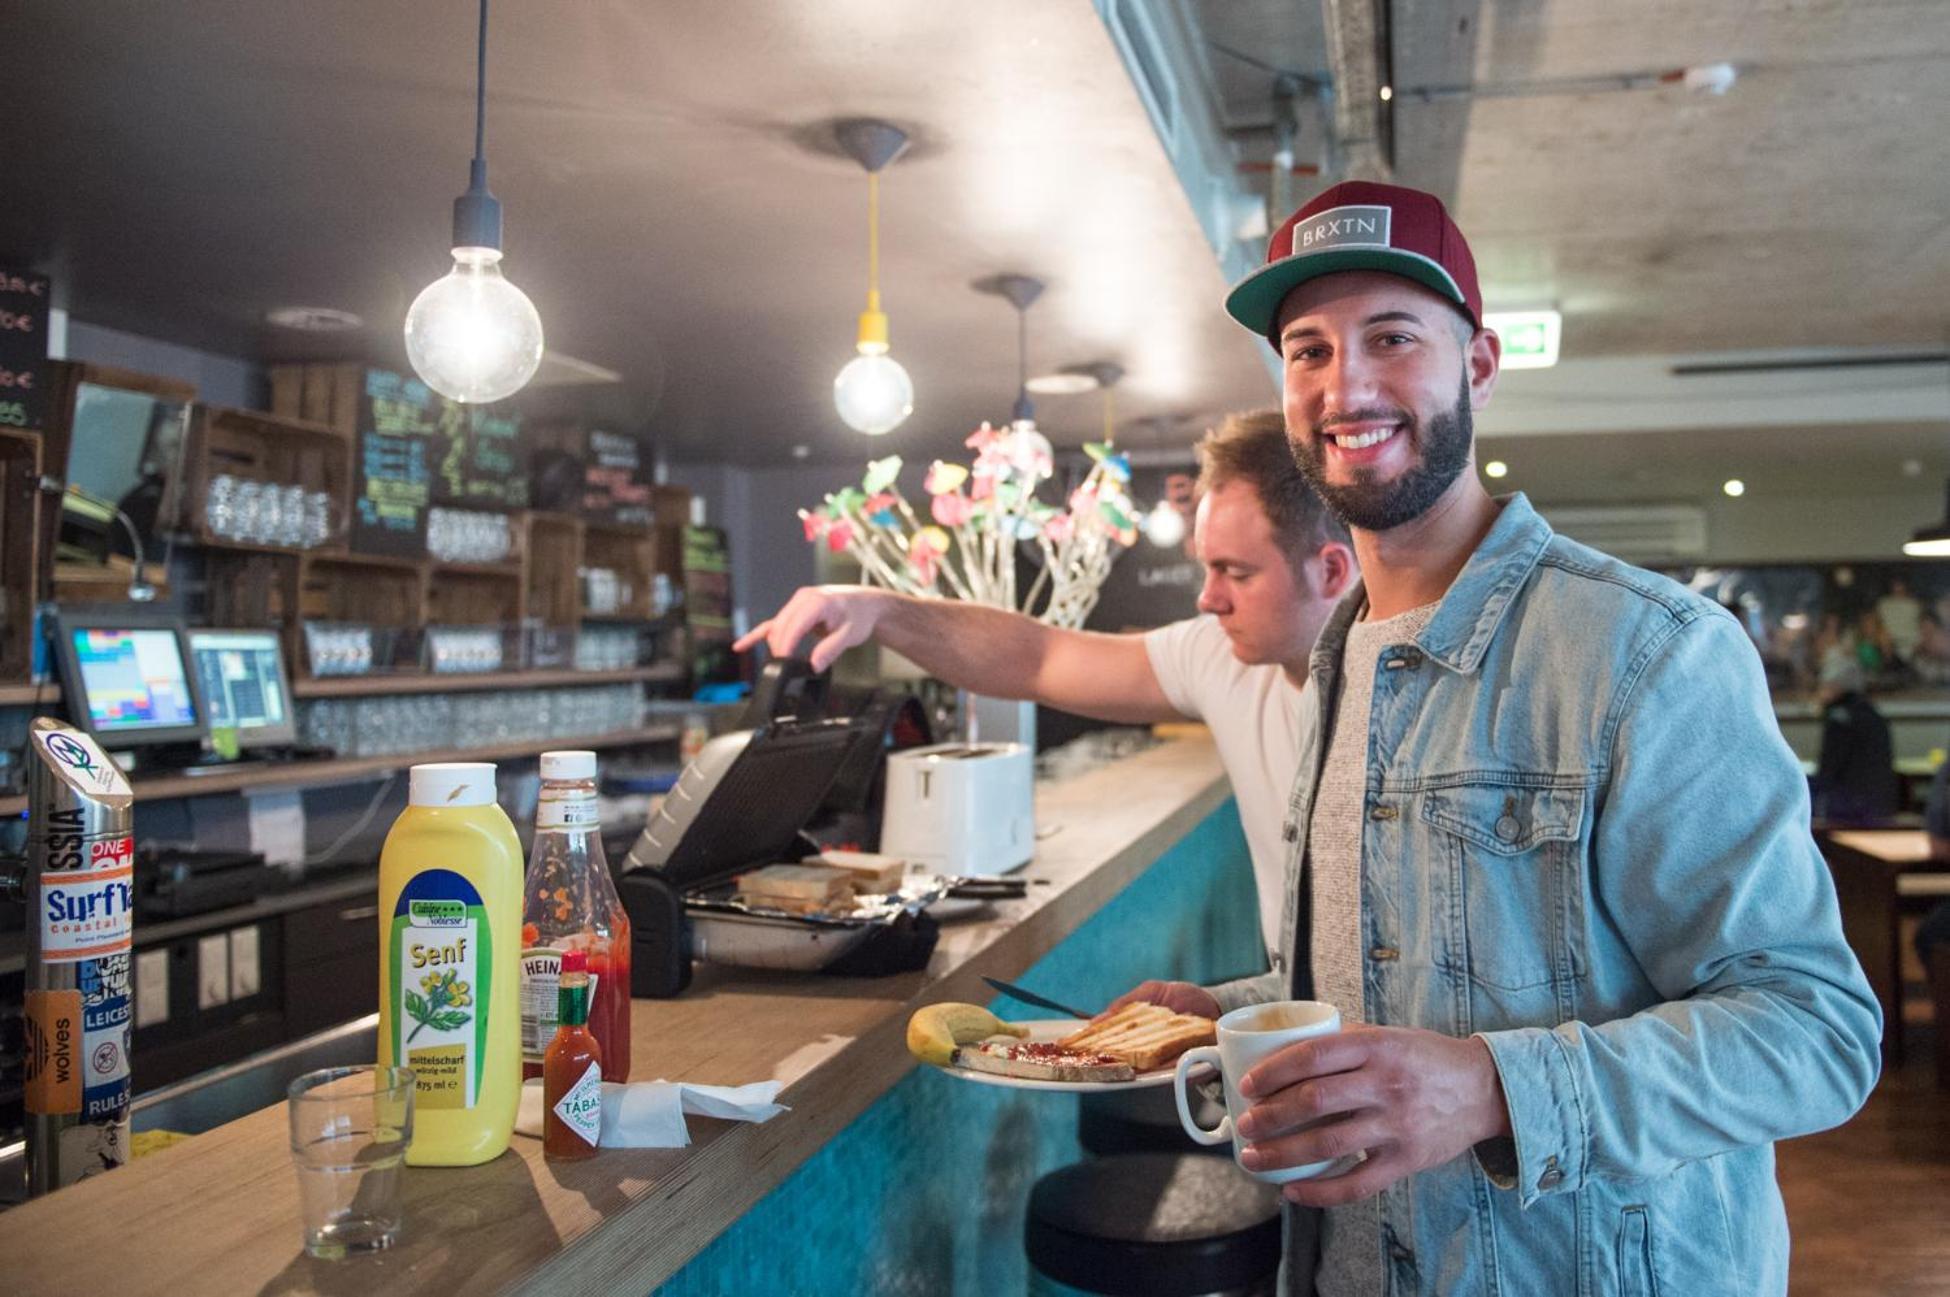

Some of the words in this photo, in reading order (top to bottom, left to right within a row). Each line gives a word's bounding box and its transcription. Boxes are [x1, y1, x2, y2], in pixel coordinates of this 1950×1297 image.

[1303, 217, 1376, 248] BRXTN
[91, 839, 125, 858] ONE
[410, 937, 467, 969] Senf
[525, 960, 562, 976] HEIN
[53, 1018, 71, 1084] wolves
[409, 1055, 465, 1066] mittelscharf
[416, 1080, 432, 1091] 875
[433, 1081, 446, 1089] ml
[562, 1097, 600, 1114] TABA
